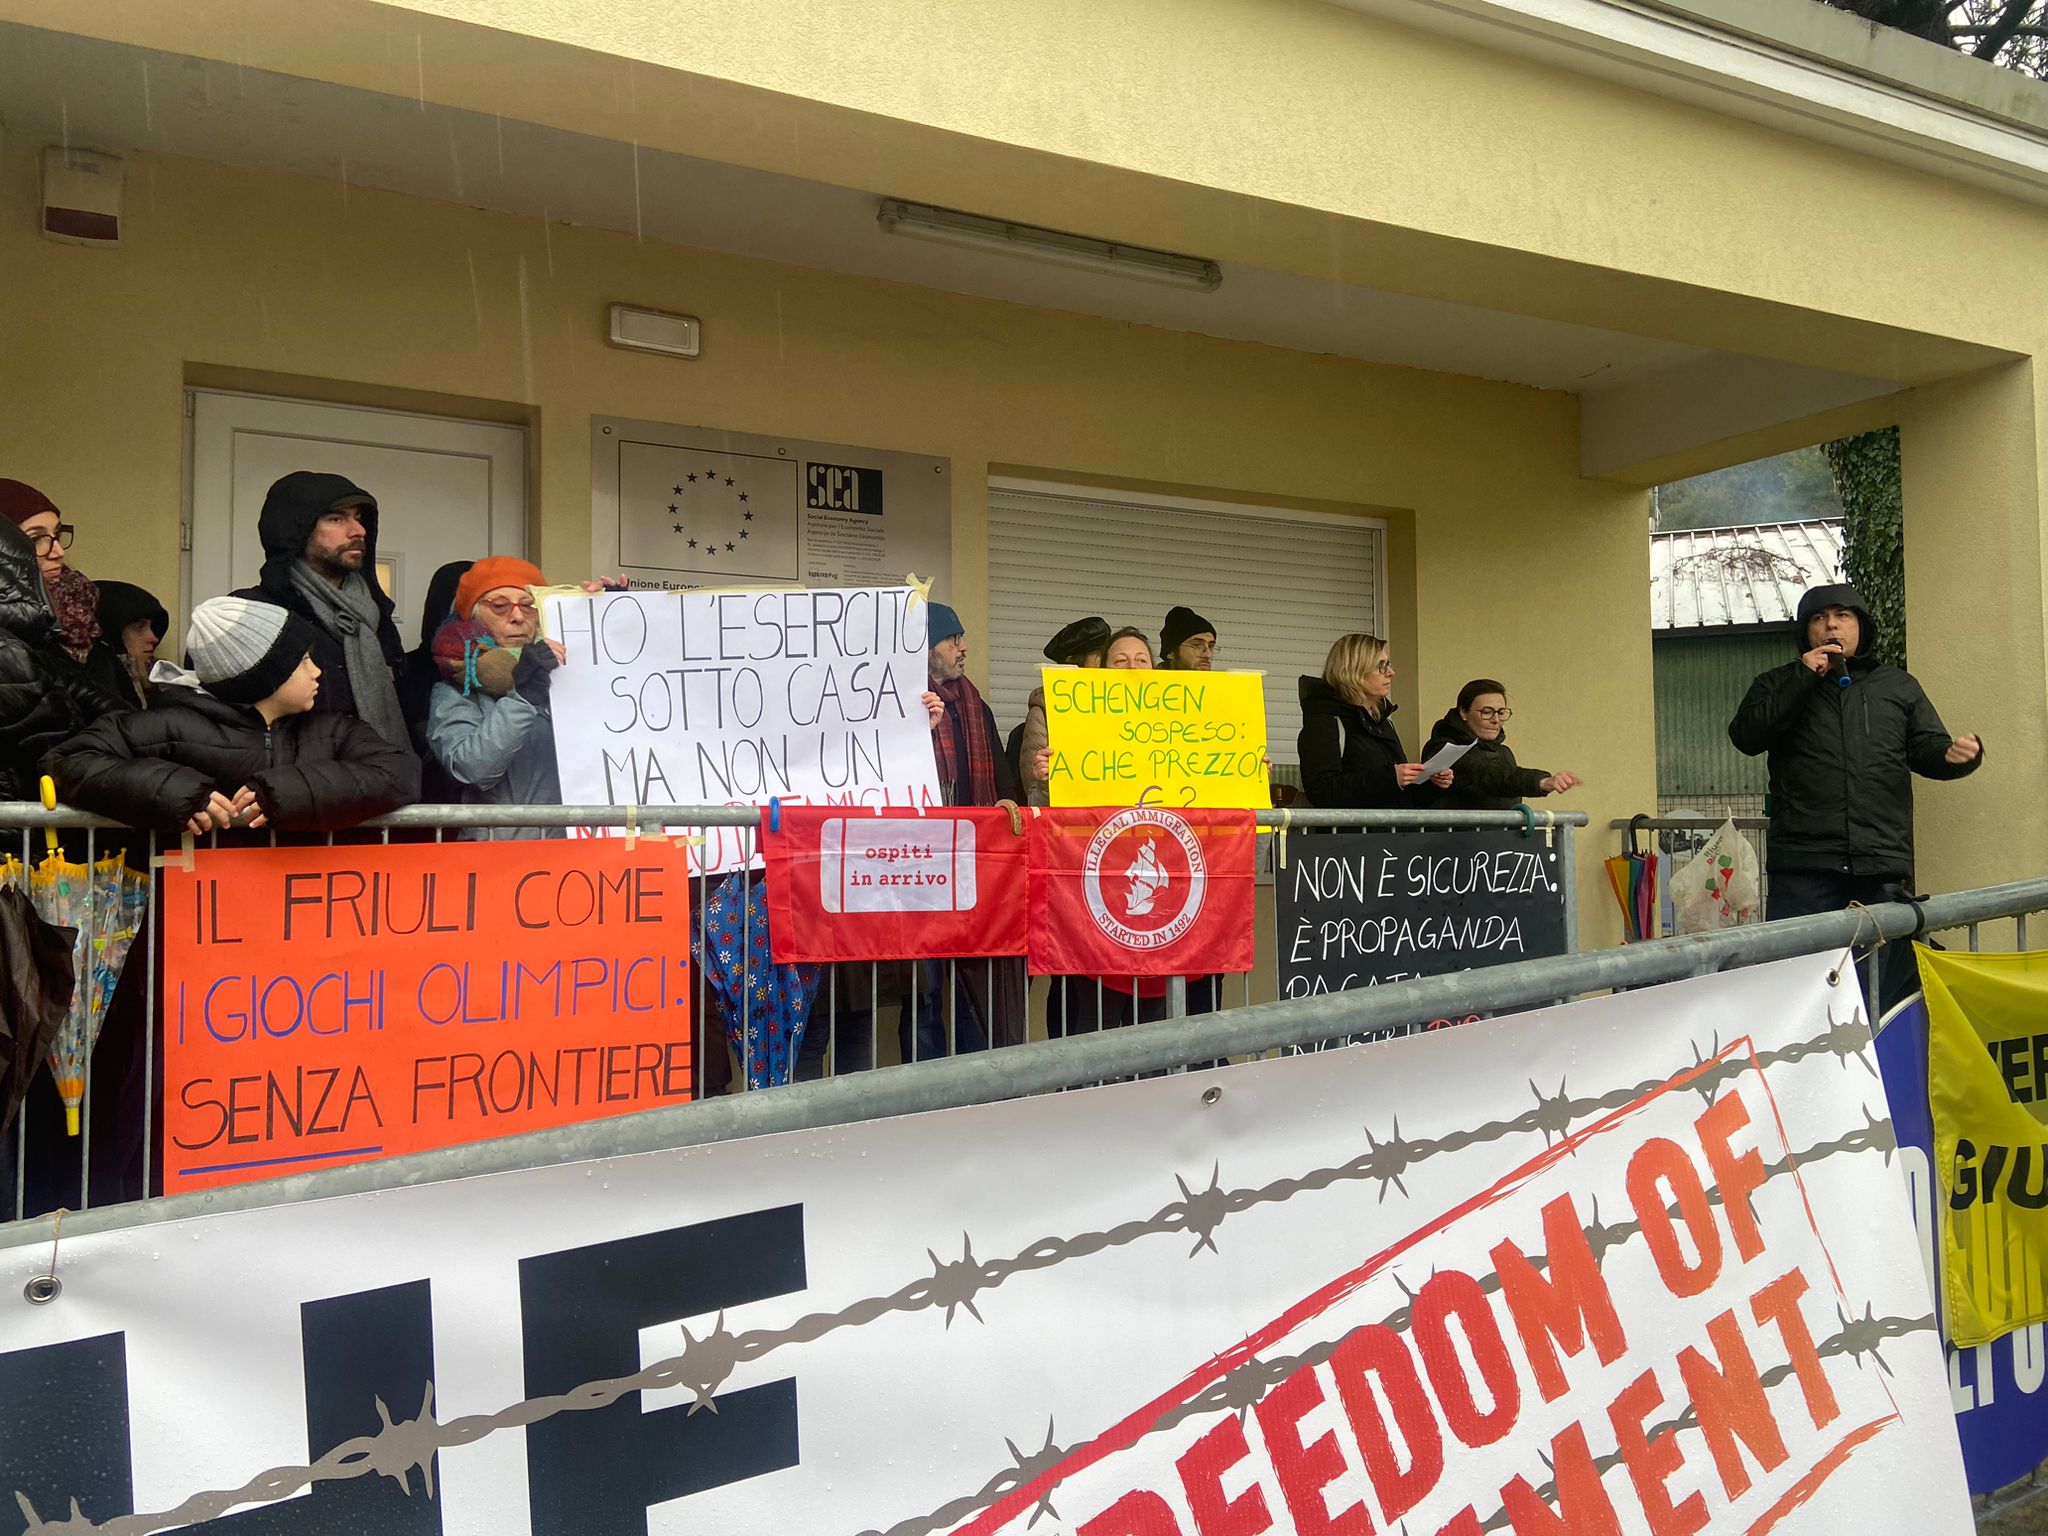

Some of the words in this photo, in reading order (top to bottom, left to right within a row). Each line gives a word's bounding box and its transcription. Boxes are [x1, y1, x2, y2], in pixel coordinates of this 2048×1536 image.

[824, 514, 848, 523] Economy
[849, 517, 869, 525] Agency
[626, 578, 660, 589] nione
[557, 594, 648, 666] HO
[680, 589, 927, 662] L'ESERCITO
[603, 665, 763, 734] SOTTO
[787, 661, 906, 727] CASA
[1052, 679, 1206, 715] SCHENGEN
[1118, 720, 1246, 745] SOSPESO:
[601, 746, 677, 806] MA
[696, 733, 791, 800] NON
[819, 729, 885, 789] UN
[1050, 750, 1074, 781] A
[1081, 749, 1137, 782] CHE
[1148, 745, 1268, 784] PREZZO?
[865, 843, 933, 863] ospiti
[1087, 816, 1129, 873] ILLEGAL
[1130, 810, 1203, 873] IMMIGRATION
[850, 870, 875, 886] in
[879, 870, 948, 887] arrivo
[1294, 855, 1365, 904] NON
[1377, 848, 1399, 898] È
[1407, 850, 1558, 897] SICUREZZA:
[196, 878, 243, 945] IL
[284, 869, 478, 941] FRIULI
[514, 867, 665, 932] COME
[1098, 912, 1150, 947] STARTED
[1152, 931, 1168, 945] IN
[1169, 912, 1192, 938] 1492
[1290, 917, 1313, 963] È
[1320, 915, 1524, 961] PROPAGANDA
[178, 980, 186, 1045] I
[203, 969, 384, 1044] GIOCHI
[417, 955, 689, 1026] OLIMPICI:
[172, 1065, 384, 1151] SENZA
[411, 1041, 692, 1124] FRONTIERE
[1076, 1191, 1629, 1536] EEDOM
[1627, 1090, 1768, 1299] OF
